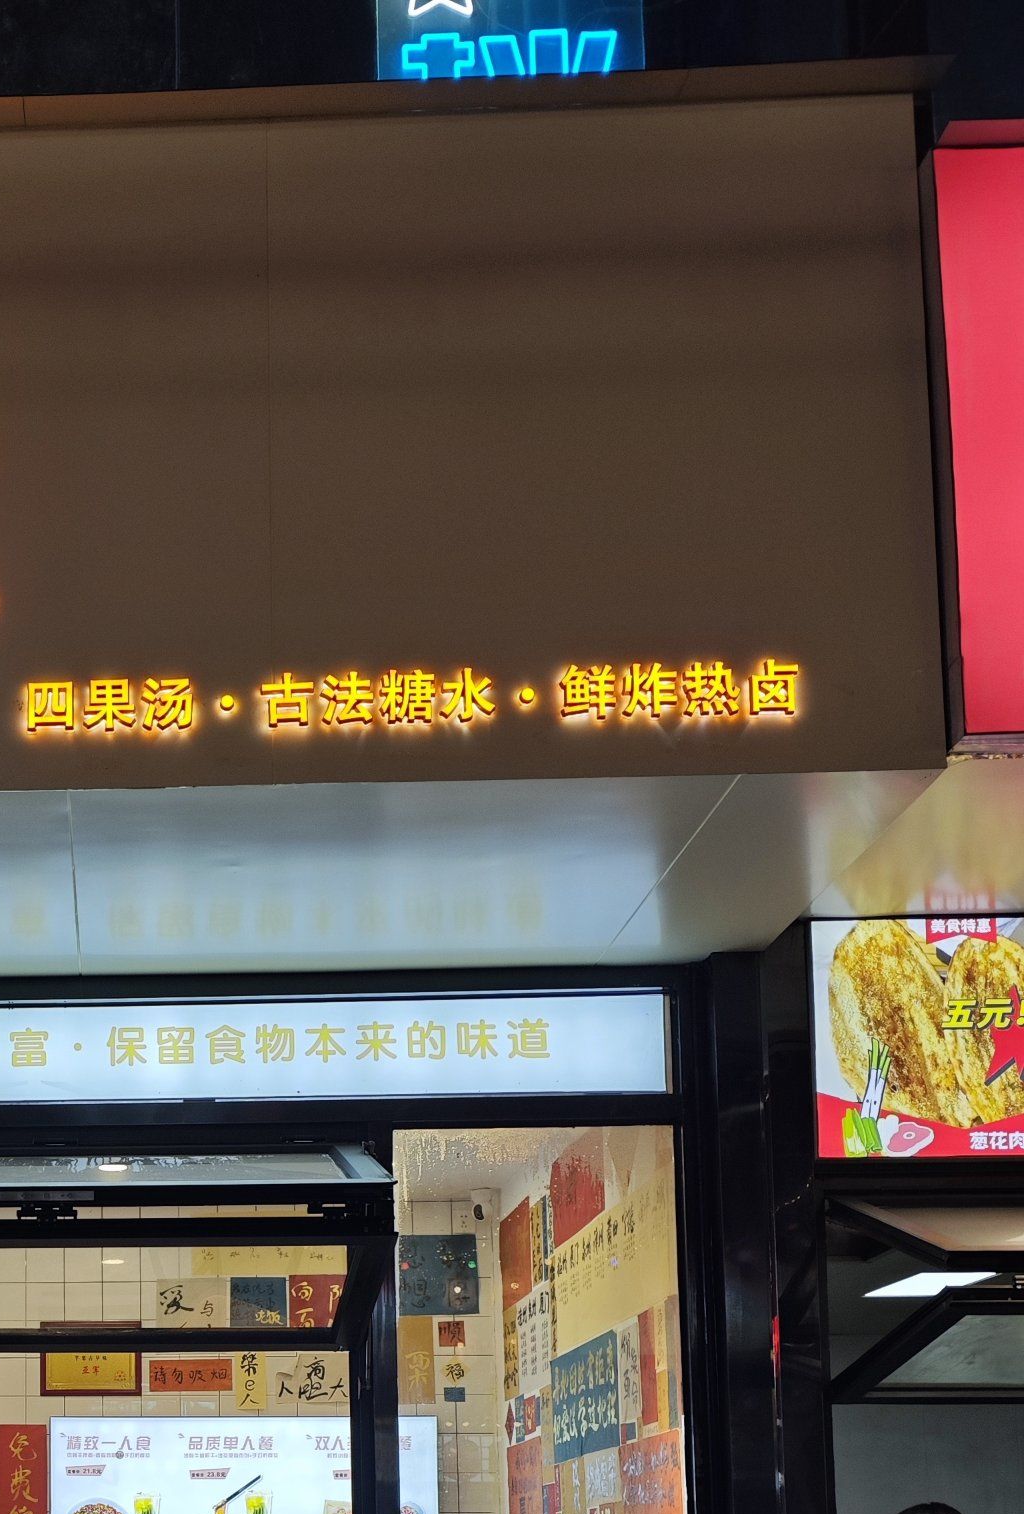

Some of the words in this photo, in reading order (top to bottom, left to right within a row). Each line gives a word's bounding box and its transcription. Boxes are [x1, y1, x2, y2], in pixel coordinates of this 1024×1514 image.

[930, 919, 991, 933] 美食特惠
[153, 1366, 226, 1385] 请勿吸烟
[446, 1363, 465, 1381] 福
[67, 1436, 151, 1450] 精致一人食
[188, 1436, 273, 1450] 品质单人餐
